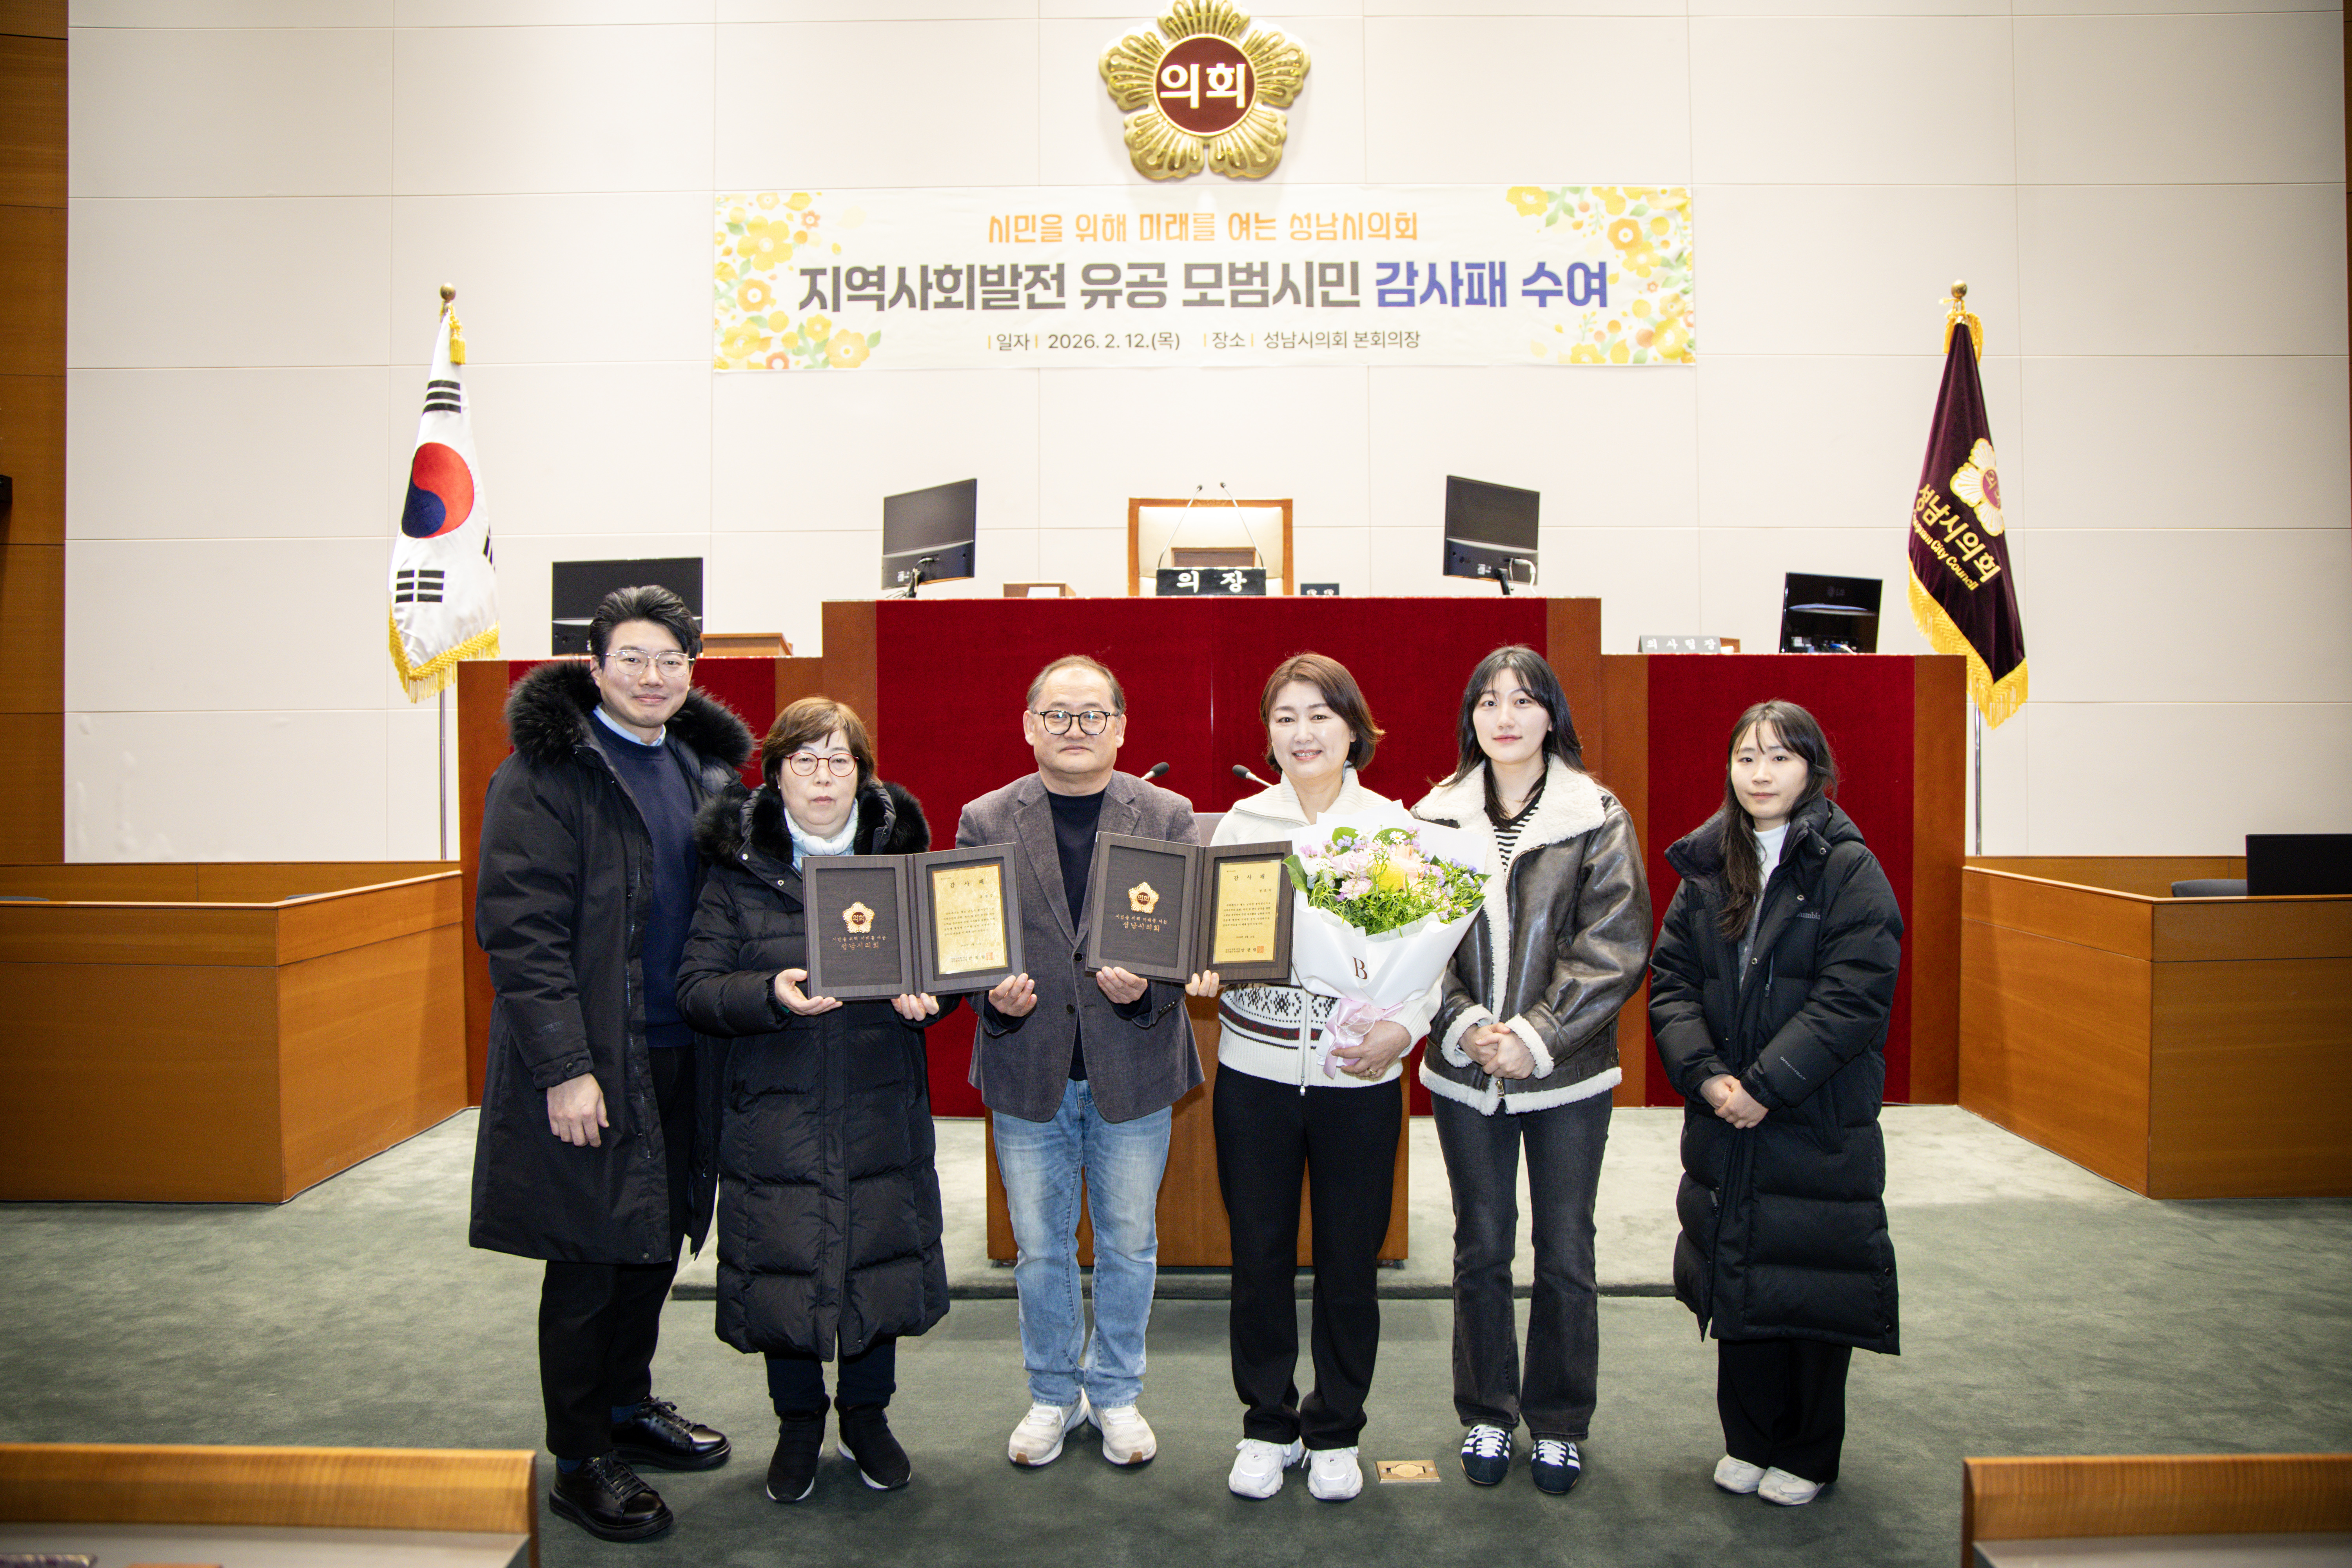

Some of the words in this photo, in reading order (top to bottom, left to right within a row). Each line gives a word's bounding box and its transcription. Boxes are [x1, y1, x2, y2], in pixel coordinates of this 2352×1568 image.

[1160, 63, 1246, 109] 의회
[989, 214, 1062, 243] 시민을
[1076, 214, 1126, 242] 위해
[1140, 213, 1215, 241] 미래를
[1228, 212, 1276, 241] 여는
[1290, 212, 1417, 241] 성남시의회
[799, 263, 1067, 312] 지역사회발전
[1080, 262, 1168, 309] 유공
[1182, 261, 1360, 308] 모범시민
[1376, 261, 1507, 308] 감사패
[1521, 260, 1609, 308] 수여
[996, 333, 1030, 350] 일자
[1048, 334, 1099, 348] 2026.
[1105, 334, 1120, 348] 2.
[1125, 332, 1180, 350] 12.(목)
[1212, 332, 1245, 348] 장소
[1264, 331, 1347, 348] 성남시의회
[1353, 331, 1421, 348] 본회의장
[1916, 484, 2001, 583] 성남시의회
[1931, 540, 1949, 560] City
[1946, 556, 1979, 591] Council
[1123, 921, 1160, 932] 성남시의회
[1796, 911, 1821, 920] lumbia
[841, 941, 879, 951] 성남시의회
[1351, 956, 1368, 980] B
